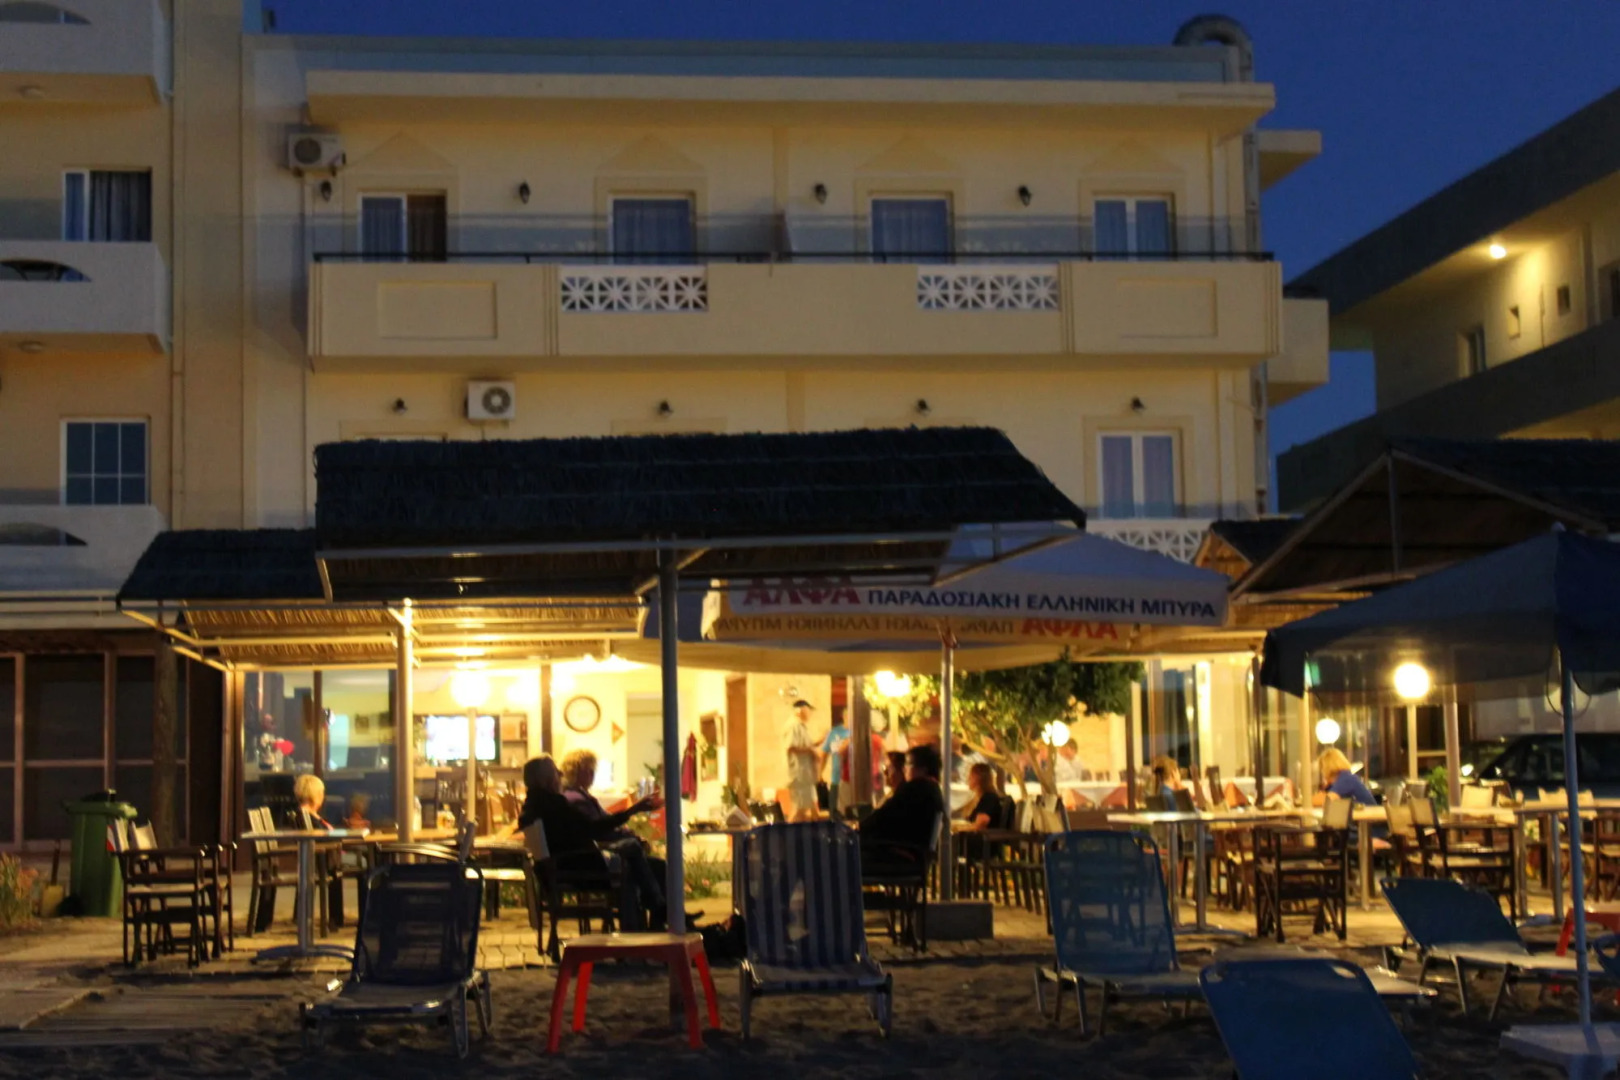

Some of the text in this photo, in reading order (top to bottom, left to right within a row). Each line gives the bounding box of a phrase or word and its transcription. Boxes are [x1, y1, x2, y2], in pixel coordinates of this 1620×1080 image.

[868, 589, 1020, 610] ΠΑΡΑΔΟΣΙΑΚΗ
[1026, 594, 1135, 614] ΕΛΛΗΝΙΚΗ
[1141, 599, 1216, 617] ΜΠΥΡΑ
